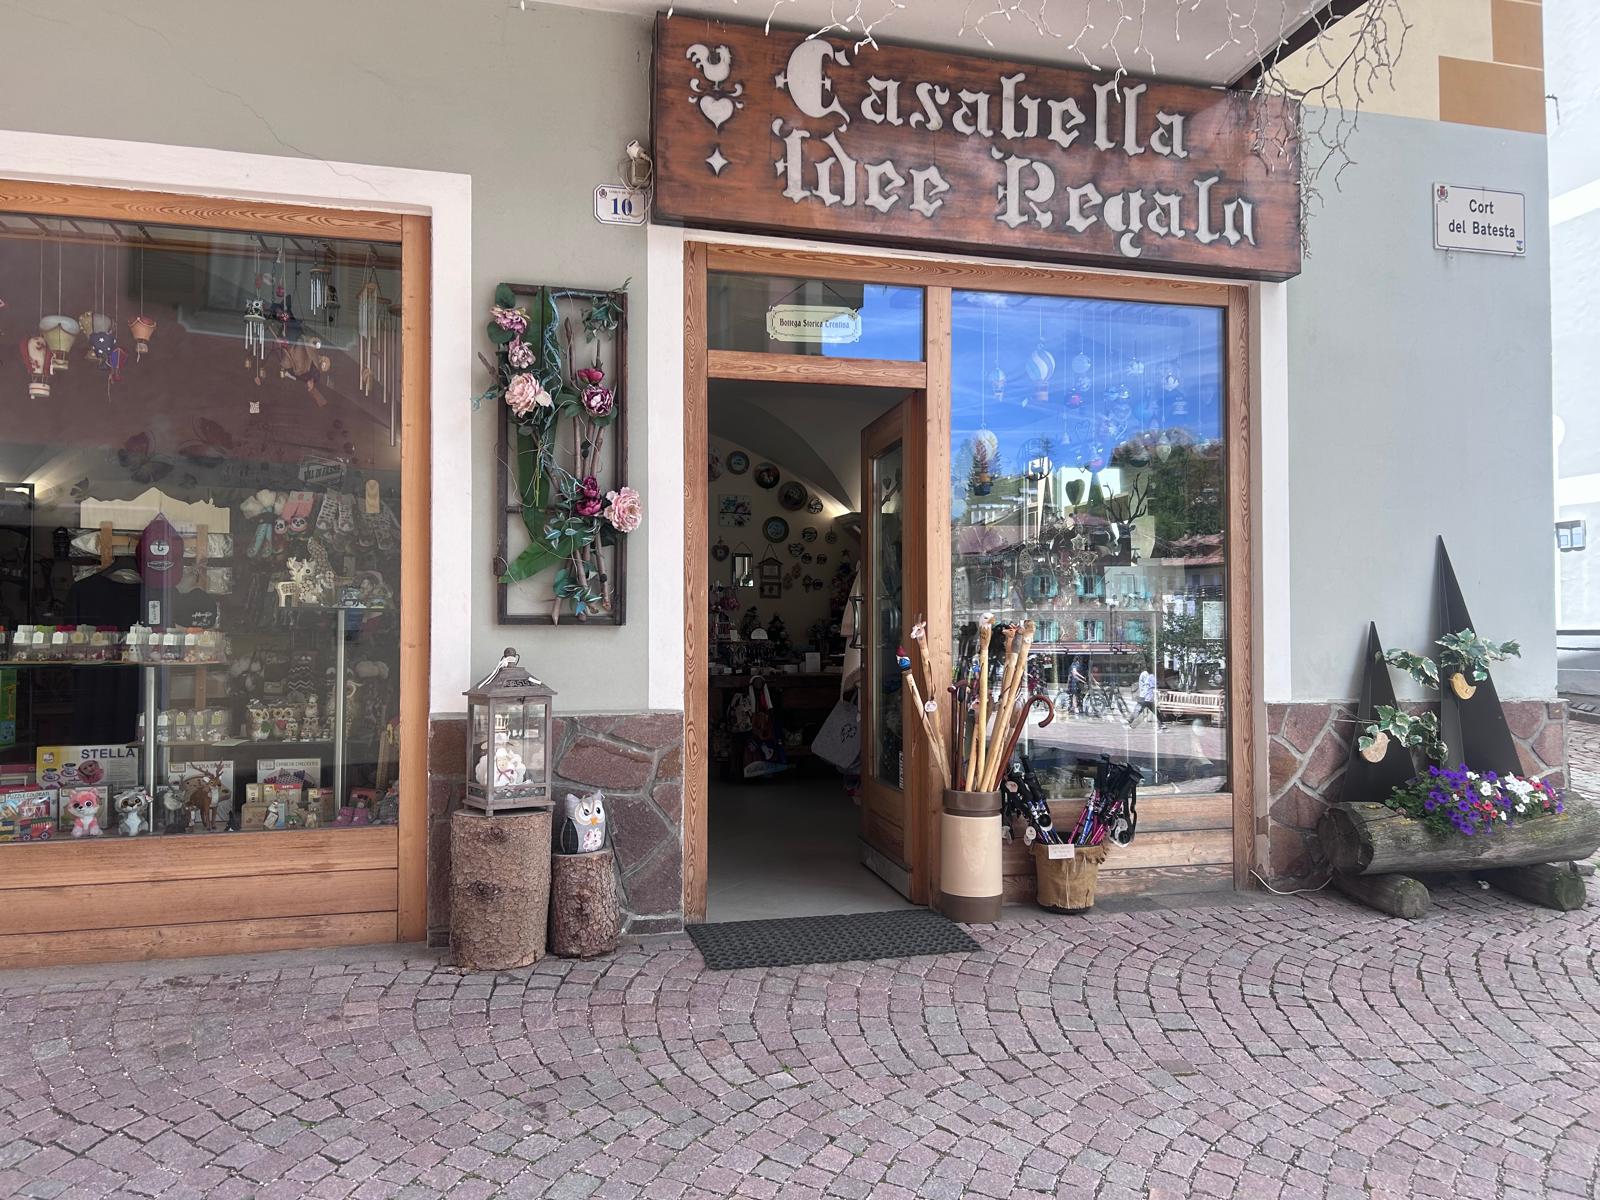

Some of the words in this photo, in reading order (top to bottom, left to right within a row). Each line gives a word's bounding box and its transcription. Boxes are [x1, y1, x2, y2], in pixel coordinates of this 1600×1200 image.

[774, 38, 1189, 159] Casabella
[772, 117, 950, 219] Idee
[991, 146, 1256, 259] Regalo
[611, 198, 633, 216] 10
[1469, 199, 1494, 214] Cort
[1448, 219, 1466, 234] del
[1472, 221, 1516, 238] Batesta
[779, 318, 801, 328] Bottega
[803, 319, 823, 328] Storica
[81, 748, 135, 759] STELLA
